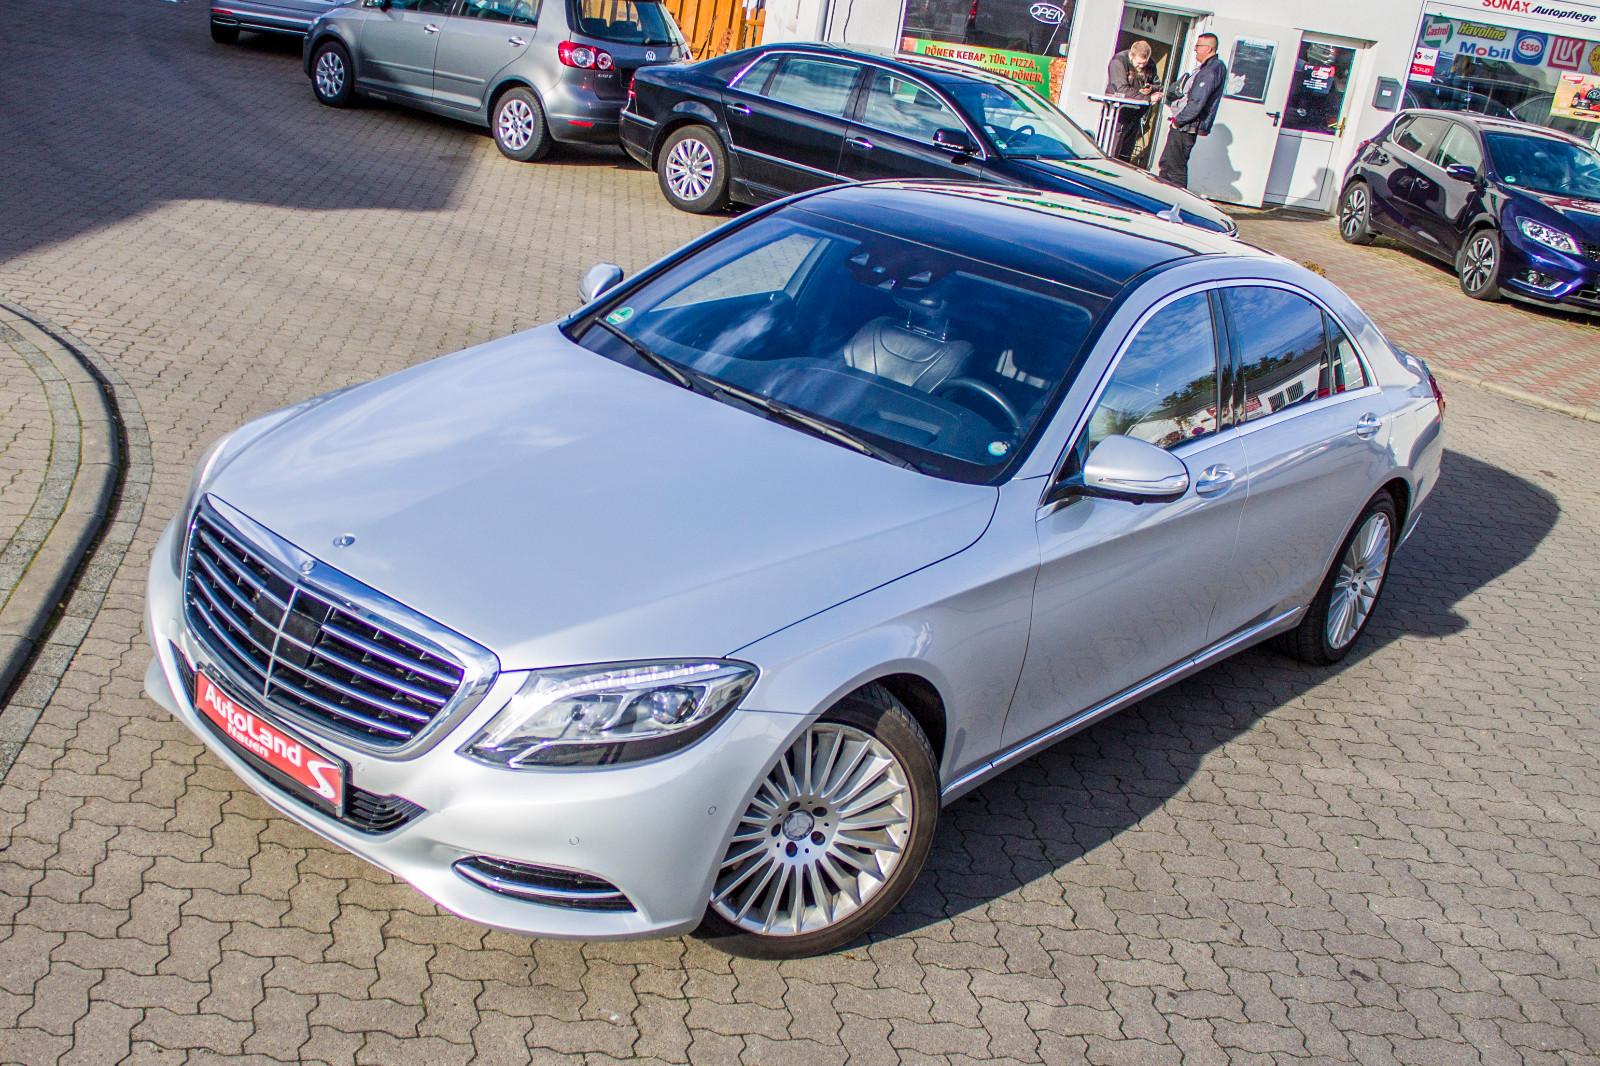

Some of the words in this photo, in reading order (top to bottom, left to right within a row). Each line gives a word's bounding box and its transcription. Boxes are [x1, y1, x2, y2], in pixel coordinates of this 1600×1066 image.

[1030, 5, 1061, 22] OPEN
[1482, 0, 1530, 13] SONAX
[1531, 5, 1597, 22] Autopflege
[1426, 24, 1450, 36] Castrol
[1458, 22, 1507, 40] Havoline
[925, 45, 955, 58] DÖNER
[956, 50, 987, 64] KEBAP,
[1459, 41, 1511, 60] Mobil
[204, 683, 301, 767] AutoLand
[227, 722, 269, 758] Nauen
